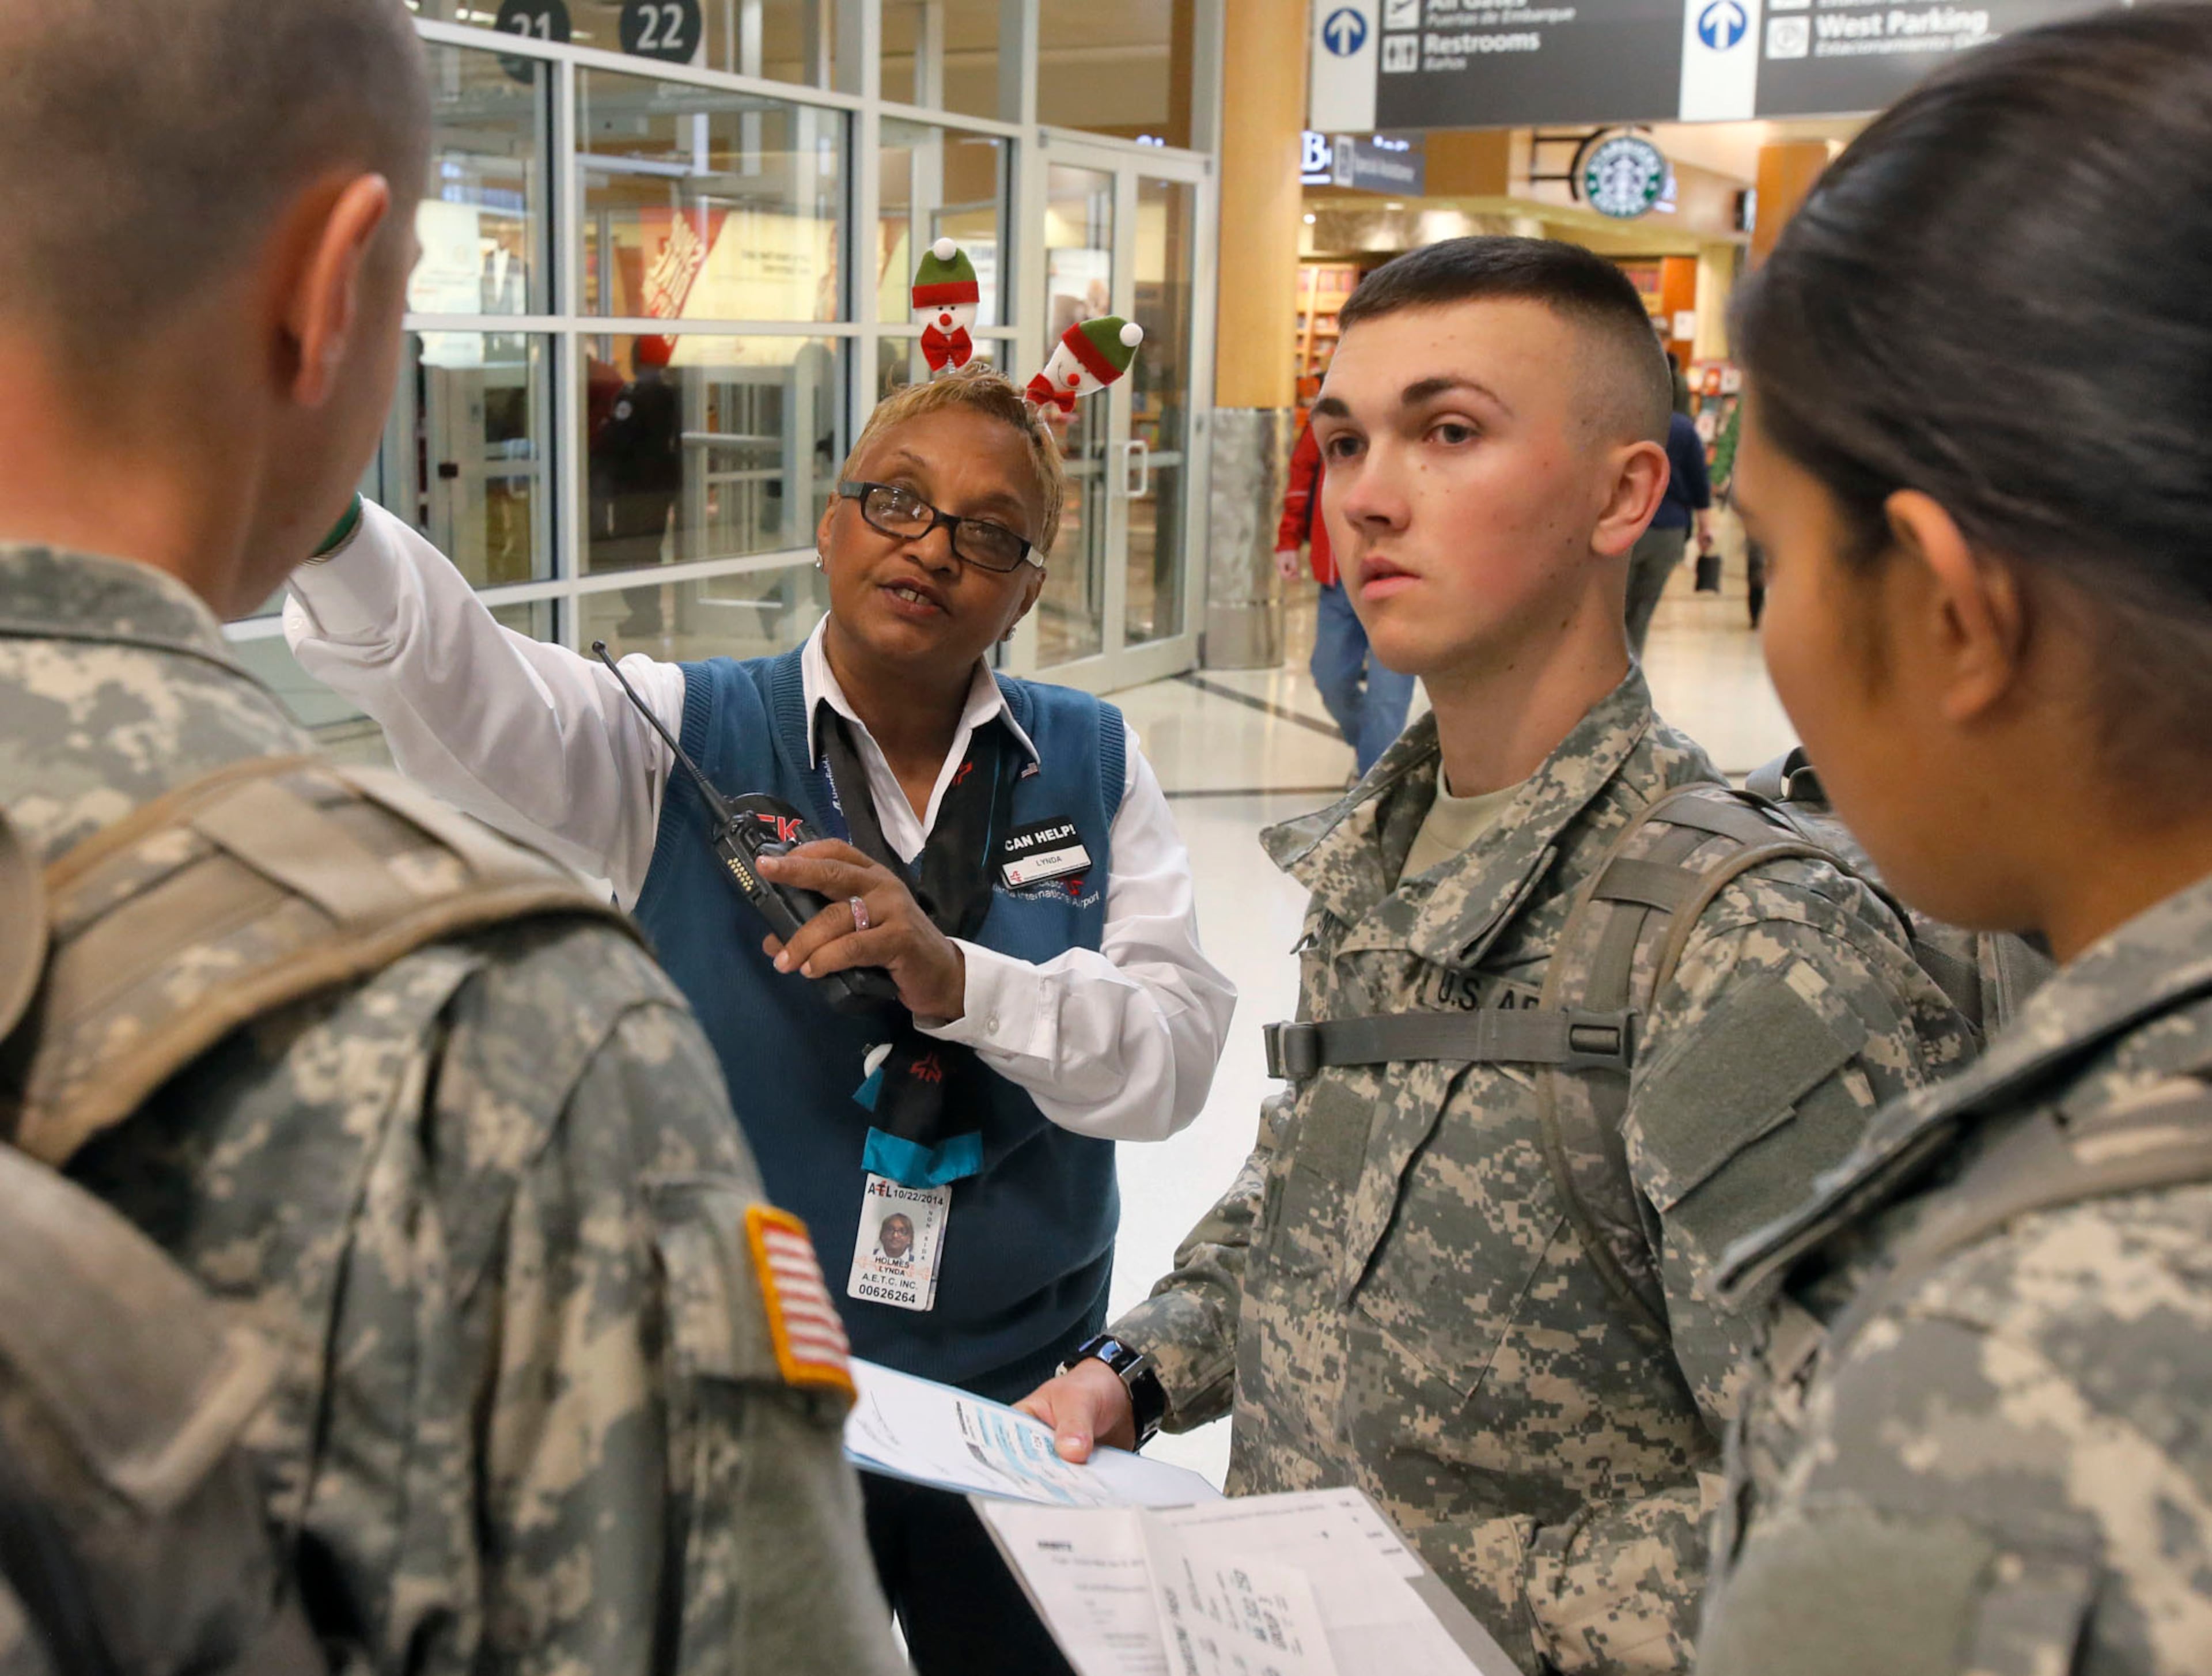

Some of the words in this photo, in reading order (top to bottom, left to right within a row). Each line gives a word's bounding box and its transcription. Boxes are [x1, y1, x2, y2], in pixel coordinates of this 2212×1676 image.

[637, 3, 684, 50] 22
[1816, 14, 1881, 37] West
[1887, 7, 1988, 36] Parking
[1424, 32, 1540, 55] Restrooms
[1301, 131, 1332, 172] B
[1005, 834, 1034, 852] CAN
[1034, 823, 1077, 843] HELP!
[1036, 856, 1063, 867] LYNDA
[1072, 891, 1100, 909] Airport
[868, 1183, 892, 1197] ATL
[893, 1189, 943, 1205] 10/22/2014
[875, 1256, 910, 1268] HOLMES
[879, 1266, 905, 1276] LYNDA
[859, 1284, 916, 1303] 00626264
[900, 1280, 918, 1290] INC.
